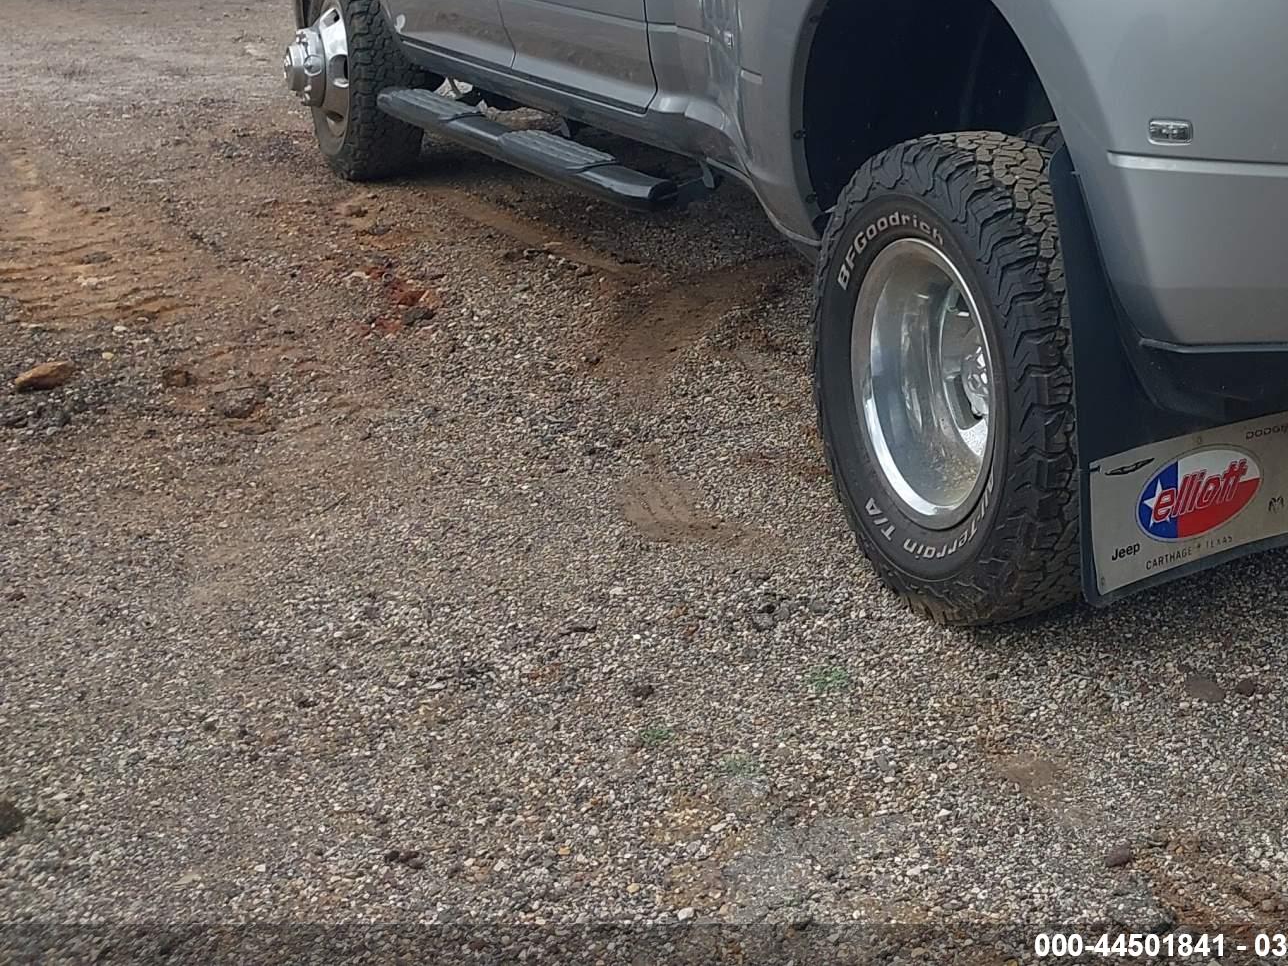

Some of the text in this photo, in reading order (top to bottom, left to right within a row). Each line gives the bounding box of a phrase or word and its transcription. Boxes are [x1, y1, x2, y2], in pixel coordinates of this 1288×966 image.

[837, 211, 945, 291] BFGoodrich
[864, 497, 897, 542] T/A
[1111, 542, 1141, 562] Jeep
[1145, 545, 1193, 571] CARTHAGE
